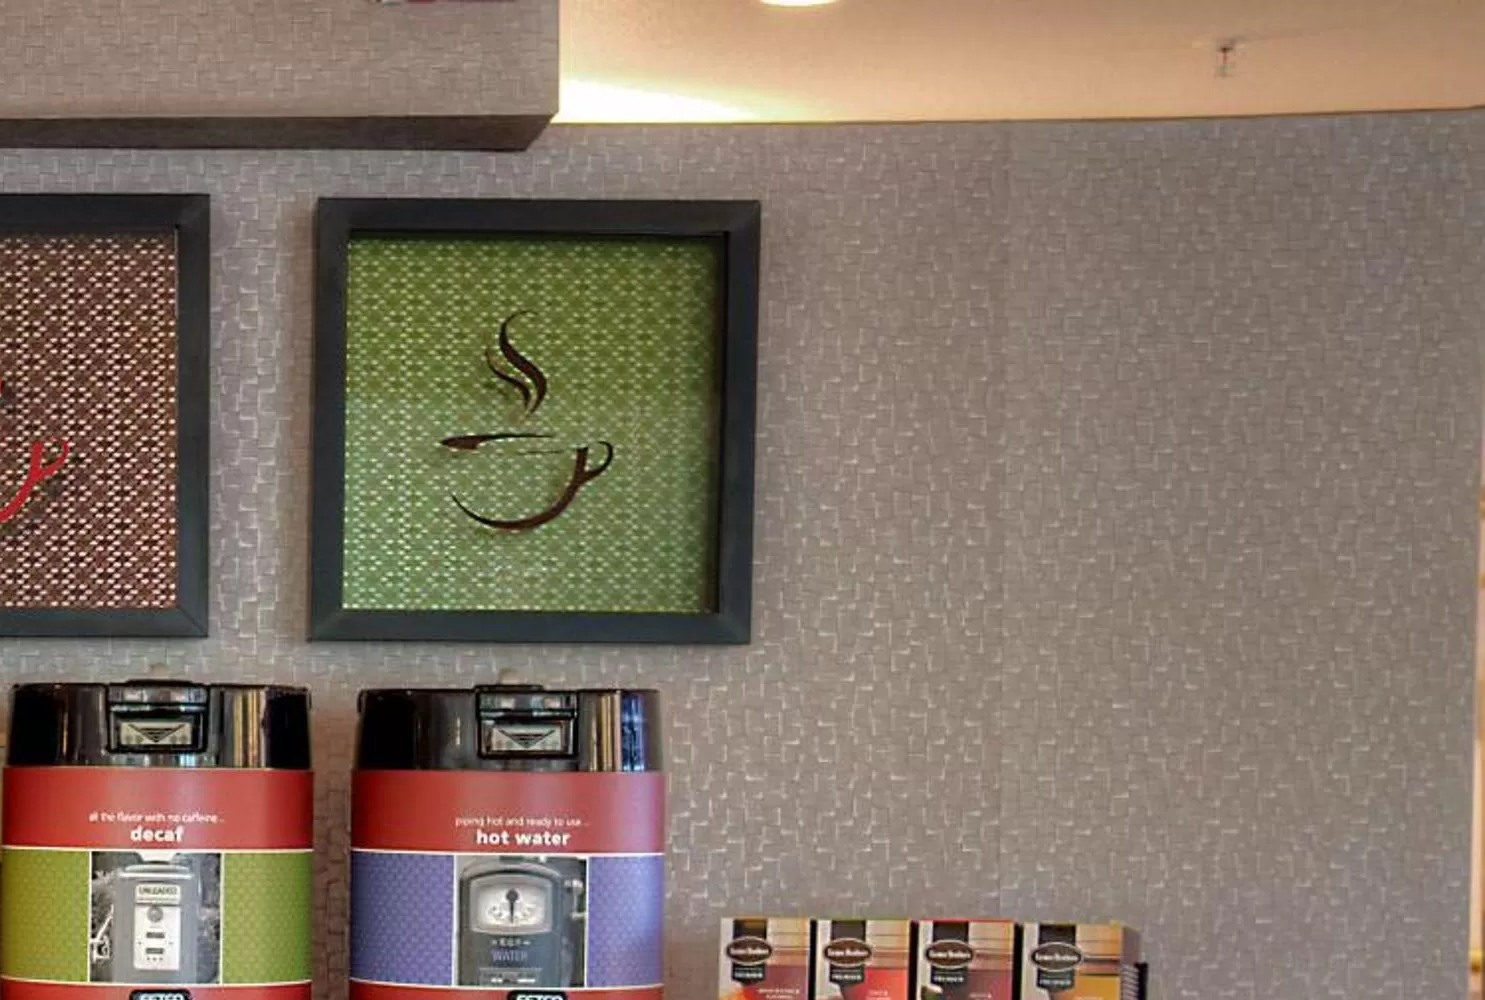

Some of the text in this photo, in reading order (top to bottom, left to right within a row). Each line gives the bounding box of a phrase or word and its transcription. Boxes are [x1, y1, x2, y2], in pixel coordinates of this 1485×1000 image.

[117, 811, 143, 822] flavor
[145, 811, 166, 822] with
[455, 816, 484, 829] piping
[487, 815, 503, 826] hot
[505, 816, 524, 826] and
[527, 816, 552, 828] ready
[554, 816, 565, 826] to
[130, 825, 184, 842] decaf
[476, 828, 572, 846] hot water
[491, 948, 528, 961] WATER
